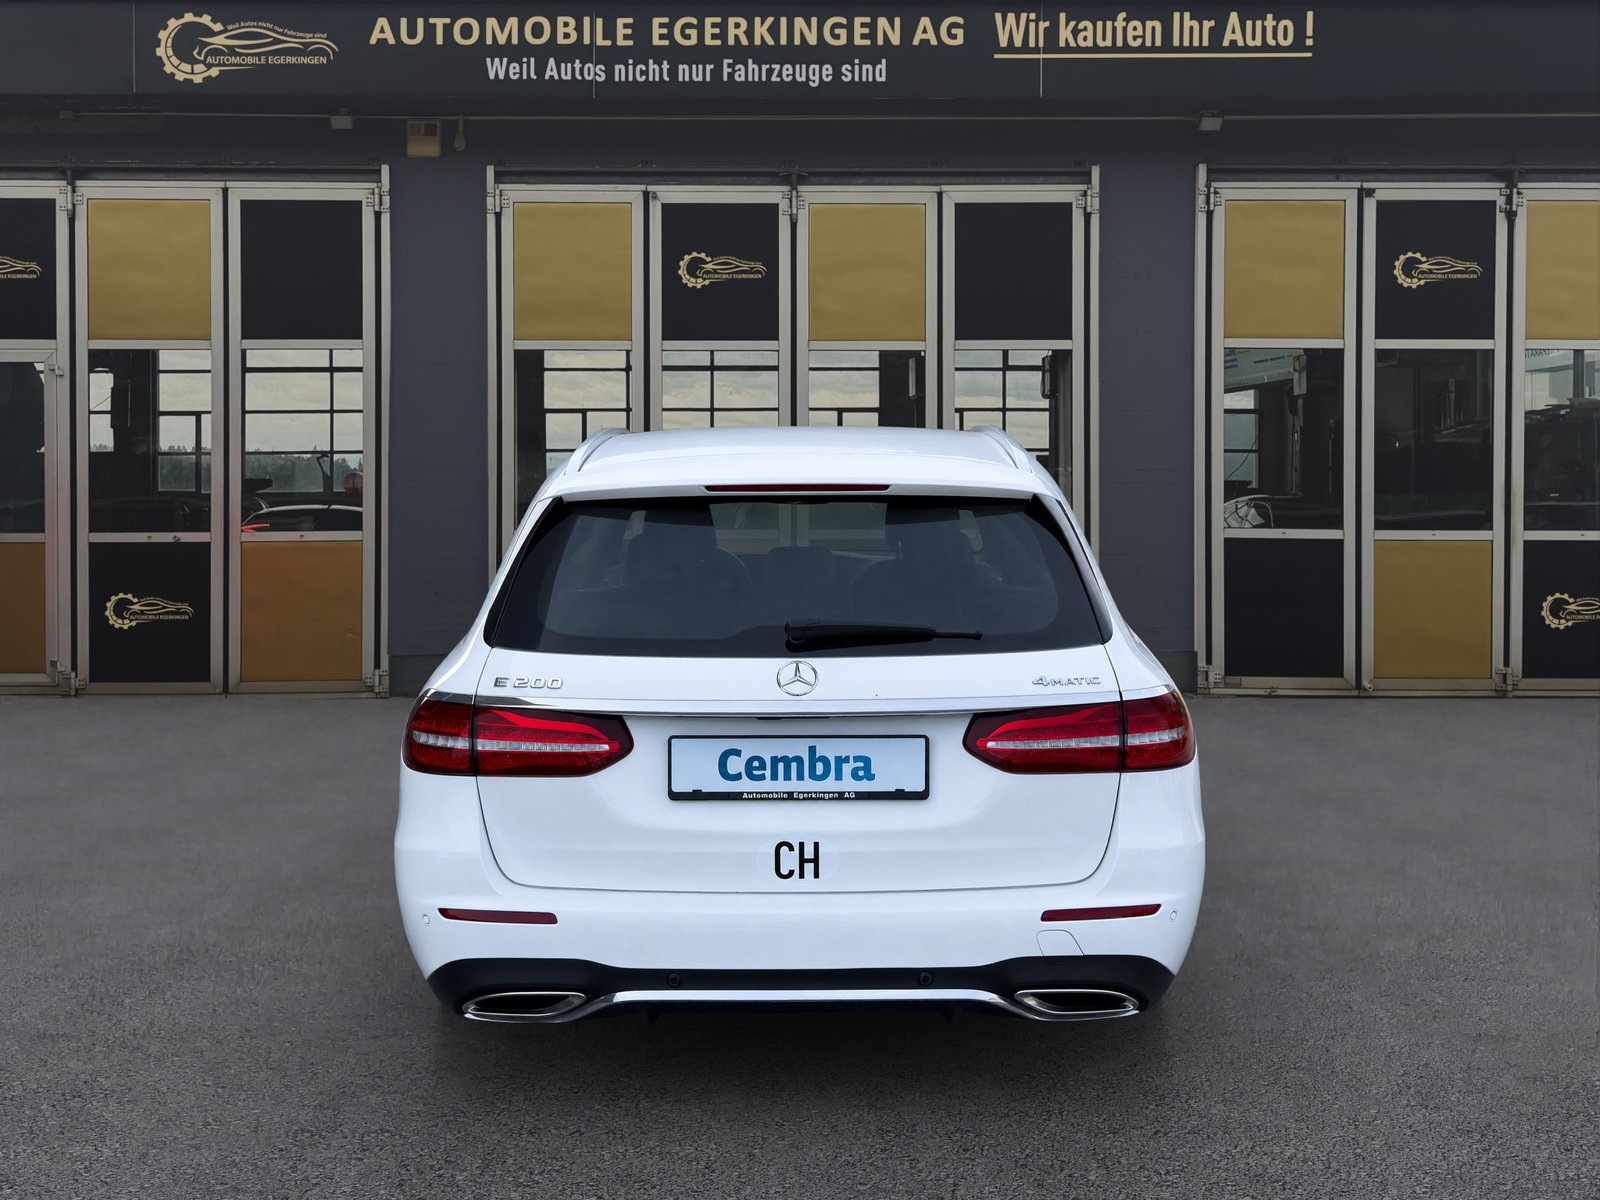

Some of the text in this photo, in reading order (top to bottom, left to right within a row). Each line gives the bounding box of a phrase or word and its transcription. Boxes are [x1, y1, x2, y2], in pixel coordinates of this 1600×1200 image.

[226, 22, 240, 31] Weil
[258, 21, 274, 29] nicht
[273, 25, 284, 33] nur
[283, 28, 314, 39] Fahrzeuge
[369, 16, 965, 47] AUTOMOBILE EGERKINGEN AG
[994, 12, 1050, 48] Wir
[1058, 12, 1162, 48] kaufen
[1172, 11, 1215, 47] Ihr
[1222, 12, 1295, 47] Auto
[205, 55, 328, 66] AUTOMOBILE EGERKINGEN
[485, 56, 887, 88] Weil Autos nicht nur Fahrzeuge sind
[493, 676, 564, 690] E 200
[1031, 675, 1102, 687] 4MATIC
[717, 744, 876, 782] Cembra
[793, 792, 839, 800] Egerkingen
[774, 840, 820, 880] CH
